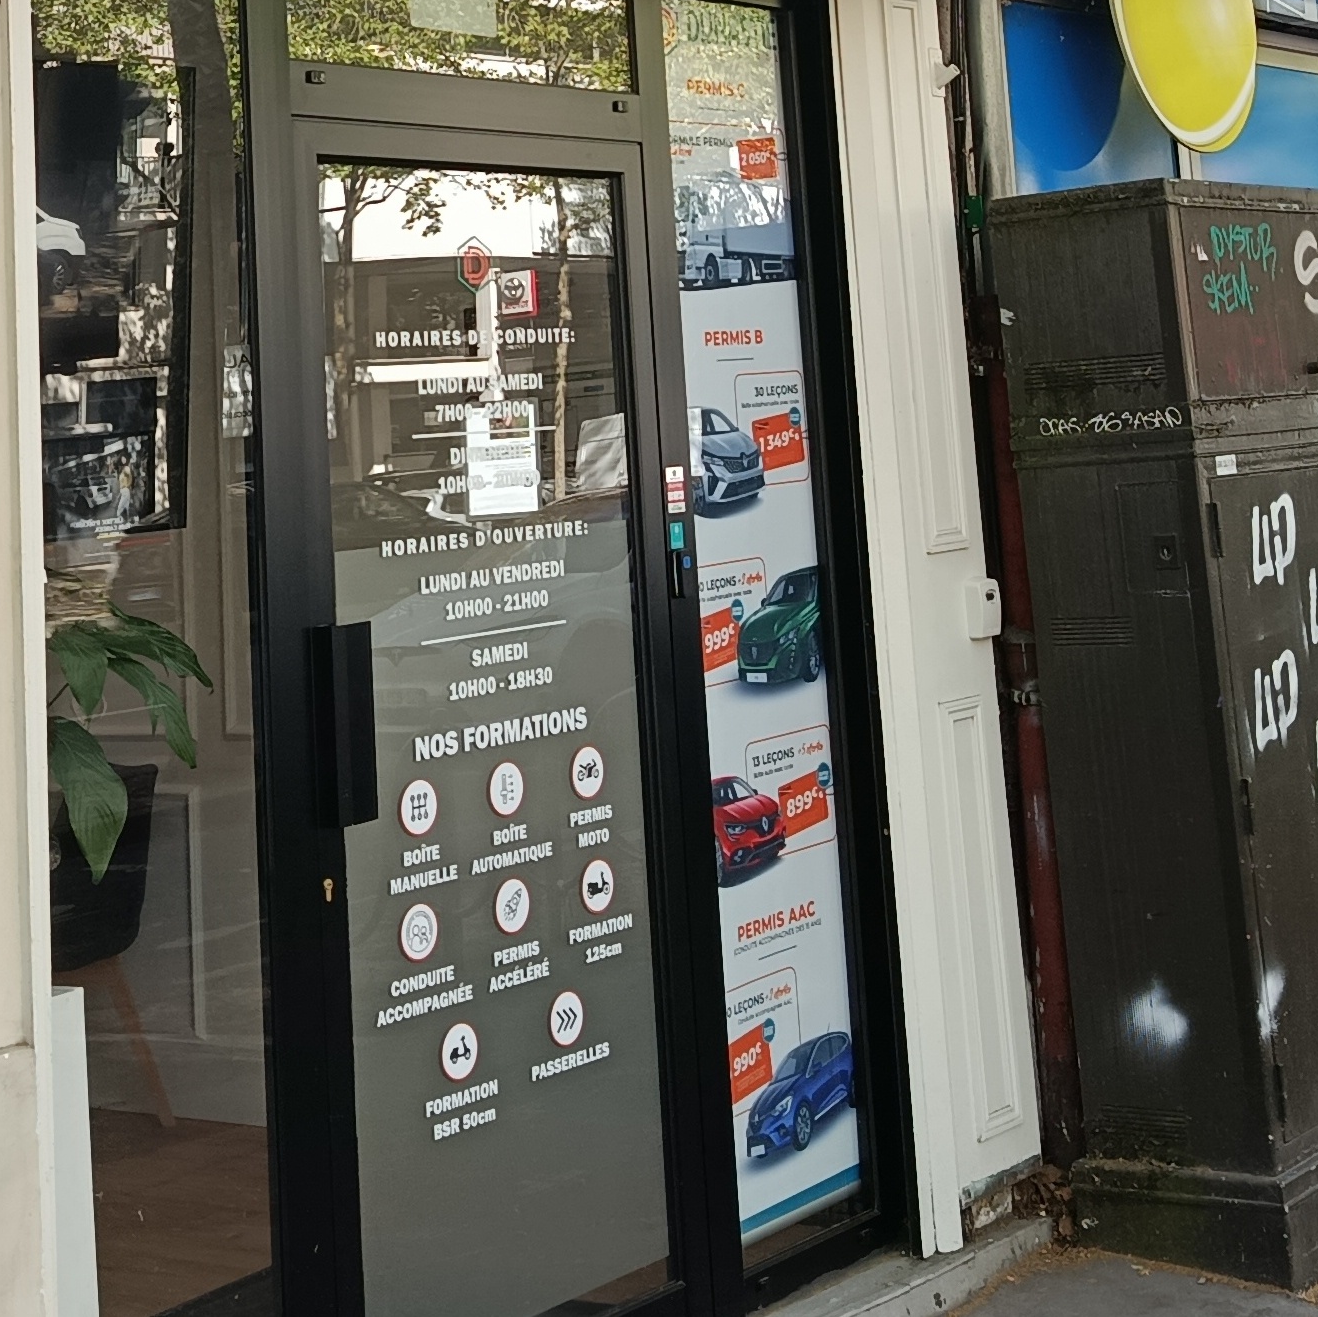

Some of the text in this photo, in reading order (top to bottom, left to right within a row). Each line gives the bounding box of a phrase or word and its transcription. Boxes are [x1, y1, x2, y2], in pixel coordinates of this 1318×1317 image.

[375, 330, 462, 348] HORAIRES
[468, 329, 487, 346] DE
[704, 329, 764, 347] PERMIS B
[418, 372, 544, 395] LUNDI AU SAMEDI
[765, 384, 799, 399] LEÇONS
[435, 403, 473, 423] 7H00
[381, 533, 469, 558] HORAIRES
[420, 559, 565, 595] LUNDI AU VENDREDI
[705, 575, 737, 593] LEÇONS
[445, 597, 493, 621] 10H00
[504, 589, 550, 613] 21H00
[471, 642, 529, 667] SAMEDI
[449, 674, 497, 702] 10H00
[508, 666, 553, 691] 18H30
[414, 706, 588, 762] NOS FORMATIONS
[762, 746, 795, 765] LEÇONS
[569, 805, 613, 828] PERMIS
[493, 823, 528, 846] BOÎTE
[578, 829, 610, 848] MOTO
[403, 844, 440, 868] BOÎTE
[471, 841, 553, 876] AUTOMATIQUE
[389, 864, 459, 895] MANUELLE
[569, 913, 634, 945] FORMATION
[737, 900, 816, 943] PERMIS AAC
[493, 941, 540, 968] PERMIS
[585, 941, 623, 964] 125cm
[390, 965, 455, 998] CONDUITE
[489, 957, 550, 993] ACCÉLÉRÉ
[376, 982, 474, 1028] ACCOMPAGNÉE
[733, 992, 765, 1016] LEÇONS
[531, 1042, 611, 1082] PASSERELLES
[425, 1079, 499, 1118] FORMATION
[434, 1106, 497, 1141] BSR 50cm
